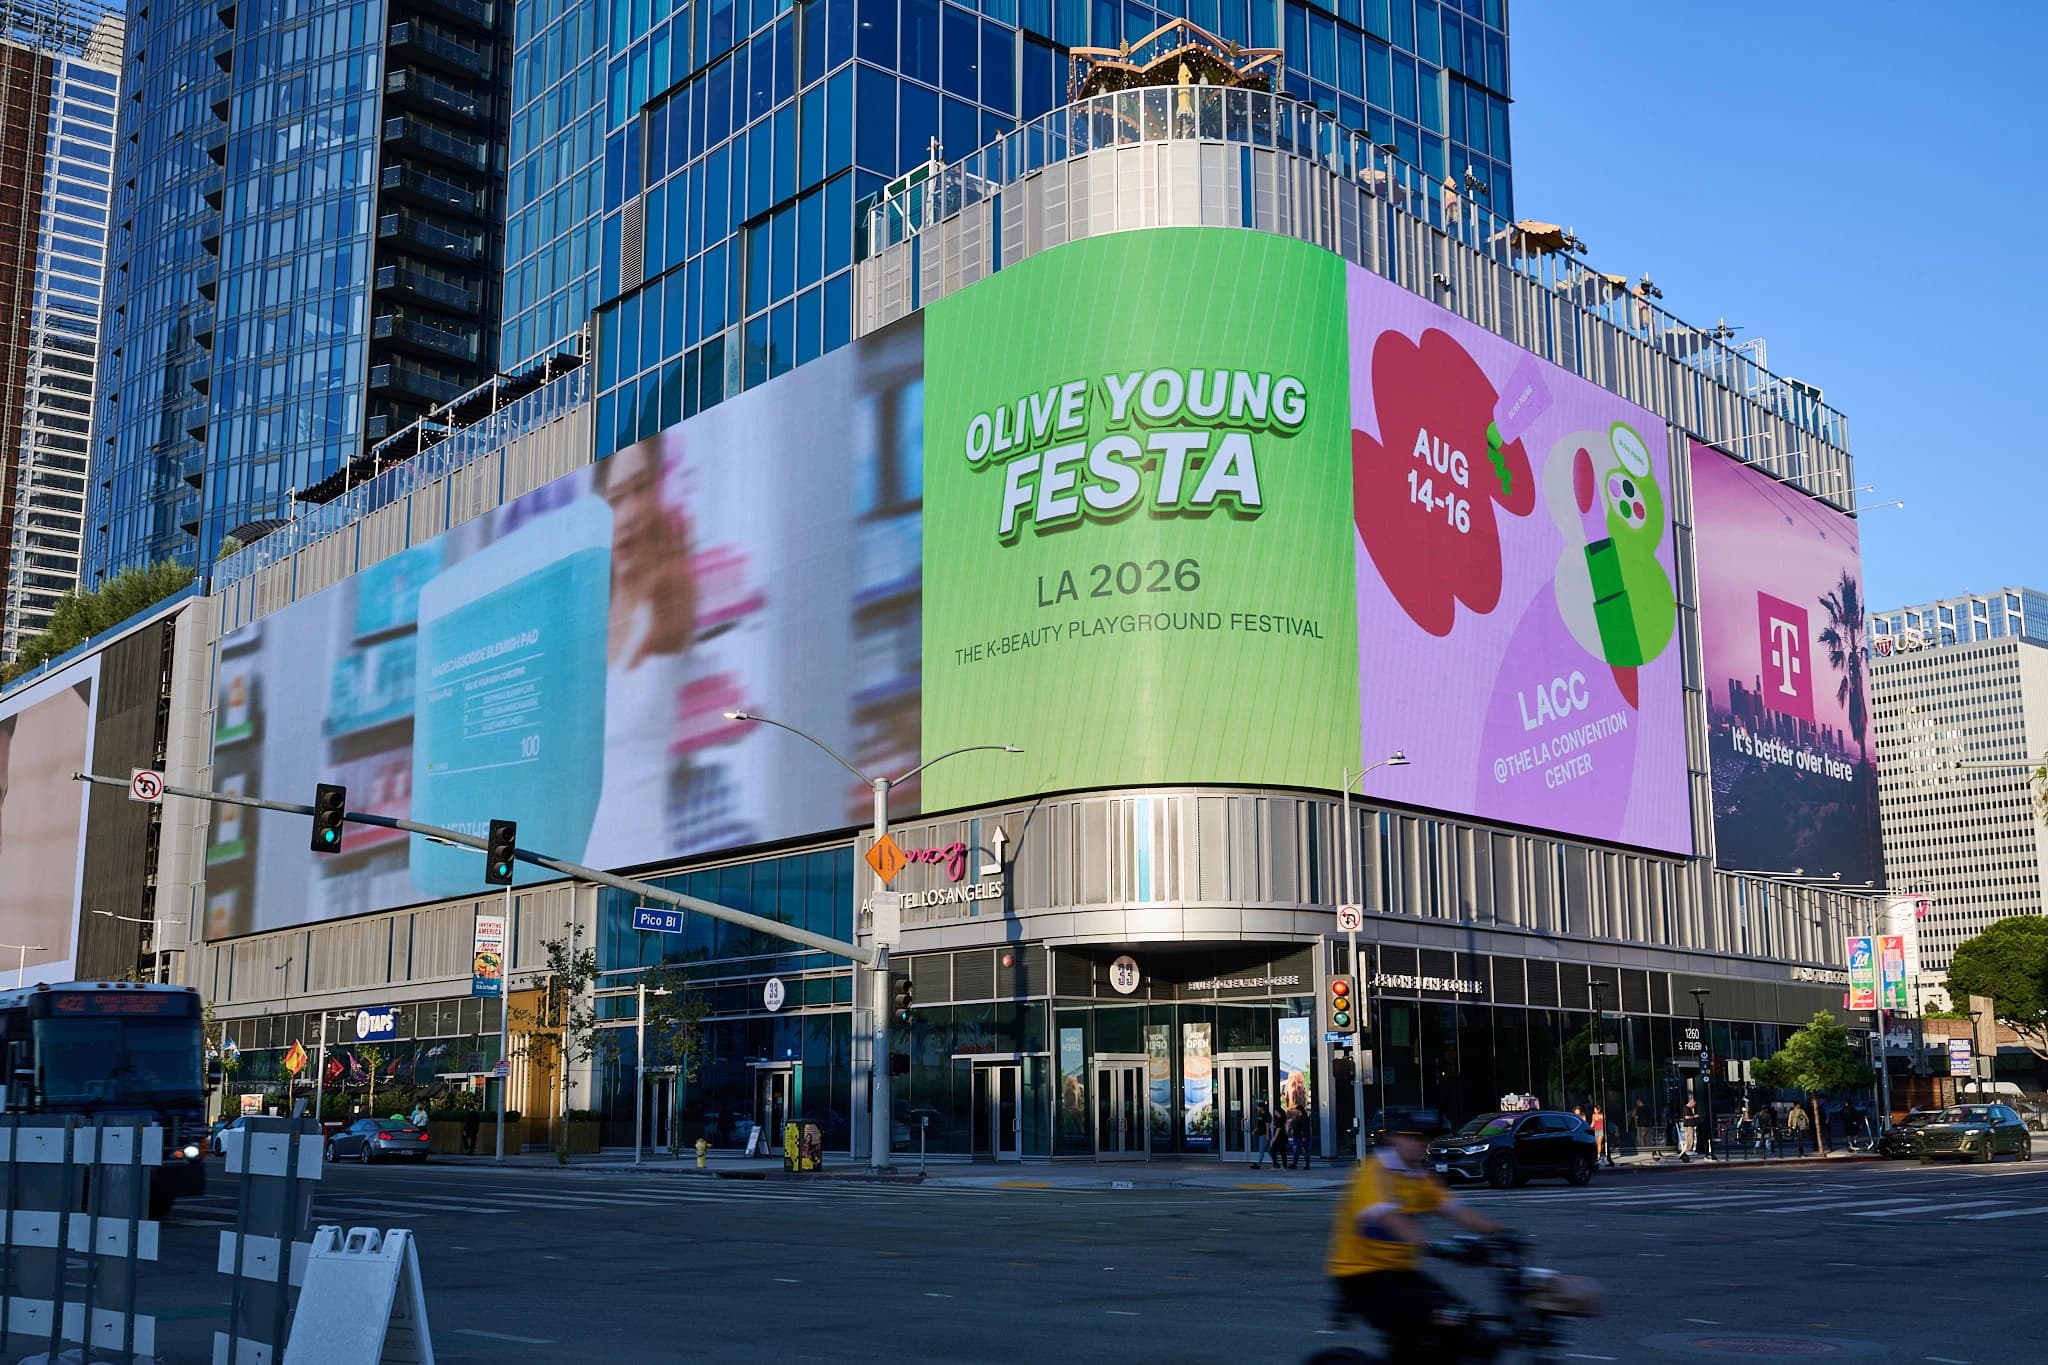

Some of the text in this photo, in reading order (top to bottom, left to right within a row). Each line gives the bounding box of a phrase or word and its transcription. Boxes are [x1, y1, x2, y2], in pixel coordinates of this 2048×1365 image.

[964, 368, 1308, 464] OLIVE YOUNG
[1413, 427, 1469, 489] AUG
[998, 431, 1262, 535] FESTA
[1407, 469, 1471, 534] 14-16
[1038, 558, 1201, 608] LA 2026
[520, 628, 539, 647] PAD
[955, 612, 1324, 667] THE K-BEAUTY PLAYGROUND FESTIVAL
[1895, 629, 1933, 651] USC
[1770, 616, 1800, 697] T
[1518, 671, 1590, 731] LACC
[521, 735, 540, 757] 100
[1494, 711, 1628, 784] @THE LA CONVENTION
[1732, 726, 1853, 782] It's better over here
[1545, 753, 1593, 789] CENTER
[921, 888, 948, 907] LOS
[946, 881, 1002, 903] ANGELES
[641, 913, 676, 927] Pico Bl
[478, 928, 501, 936] AMERICA
[1118, 964, 1133, 985] 33
[769, 983, 778, 998] 33
[370, 1015, 393, 1032] TAPS
[1286, 1027, 1302, 1035] NOW
[1685, 1028, 1699, 1039] 1260
[1187, 1039, 1209, 1049] OPEN
[1189, 1032, 1204, 1040] NOW
[1283, 1035, 1306, 1045] OPEN
